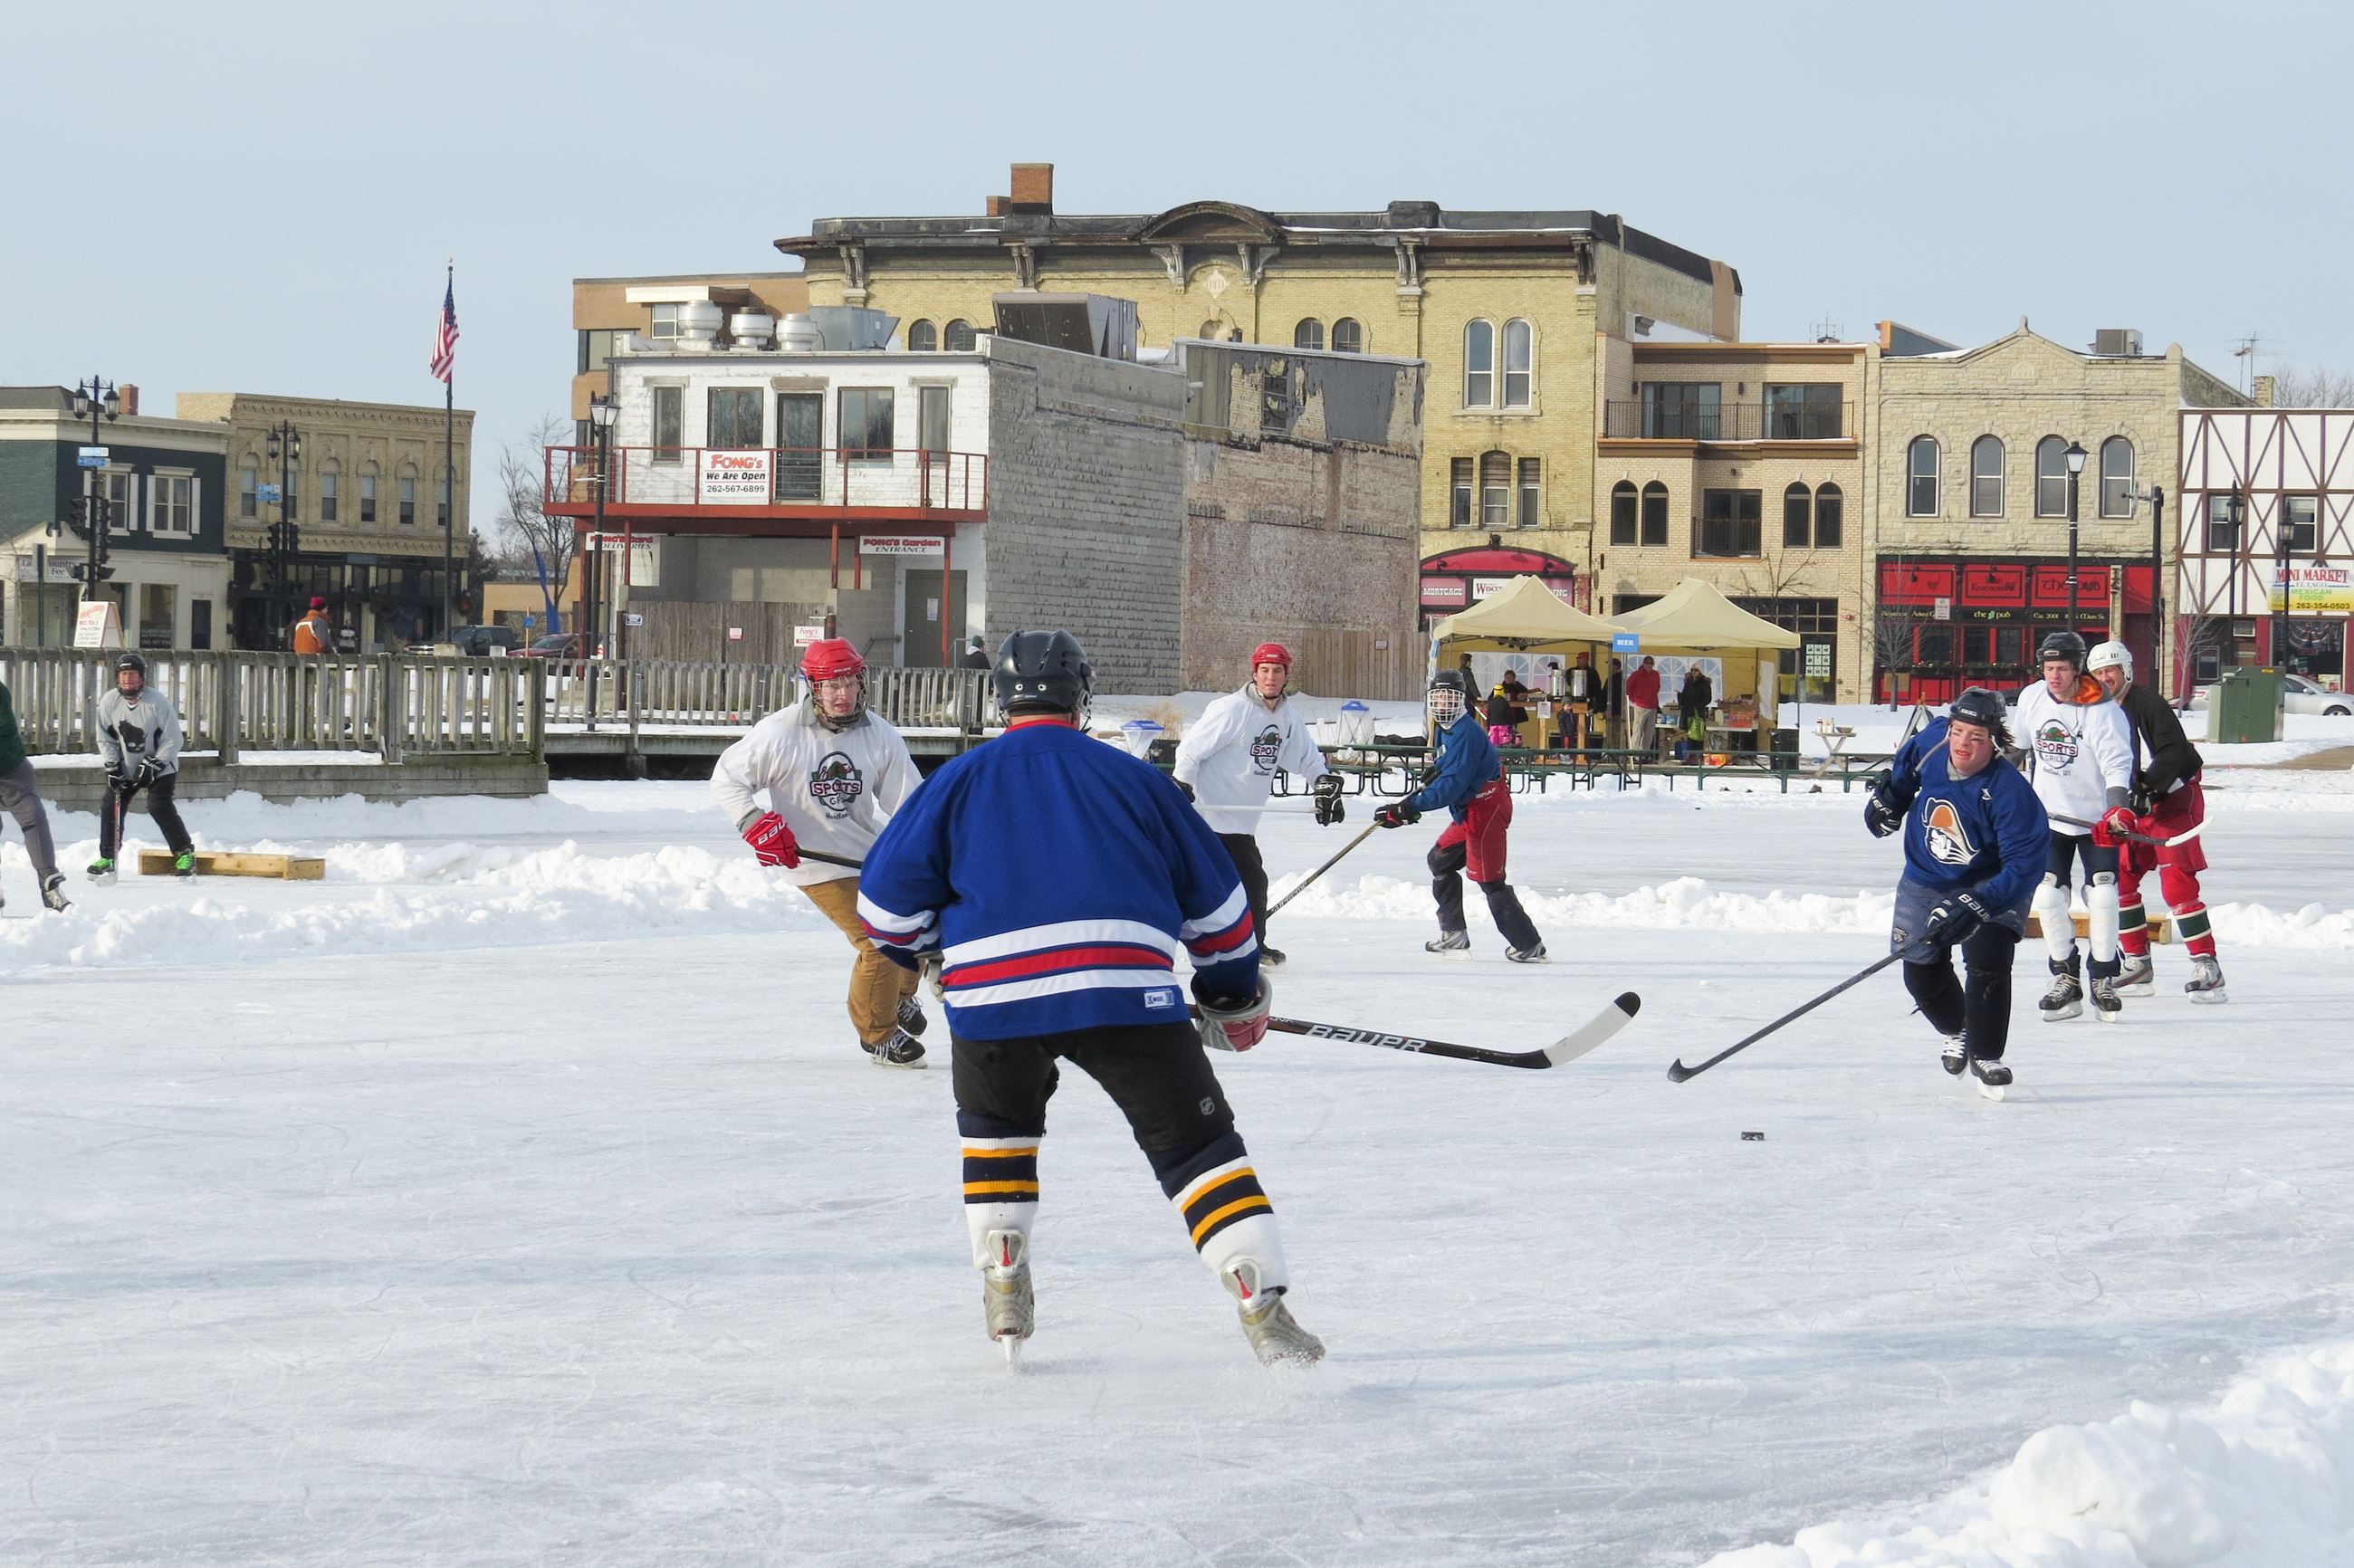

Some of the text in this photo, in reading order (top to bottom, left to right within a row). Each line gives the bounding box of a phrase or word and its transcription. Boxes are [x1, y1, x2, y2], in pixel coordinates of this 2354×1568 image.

[742, 473, 766, 481] Open
[2276, 569, 2349, 584] MNI MARKET
[1422, 588, 1463, 596] MORTGAGE
[2036, 739, 2077, 755] SPORTS
